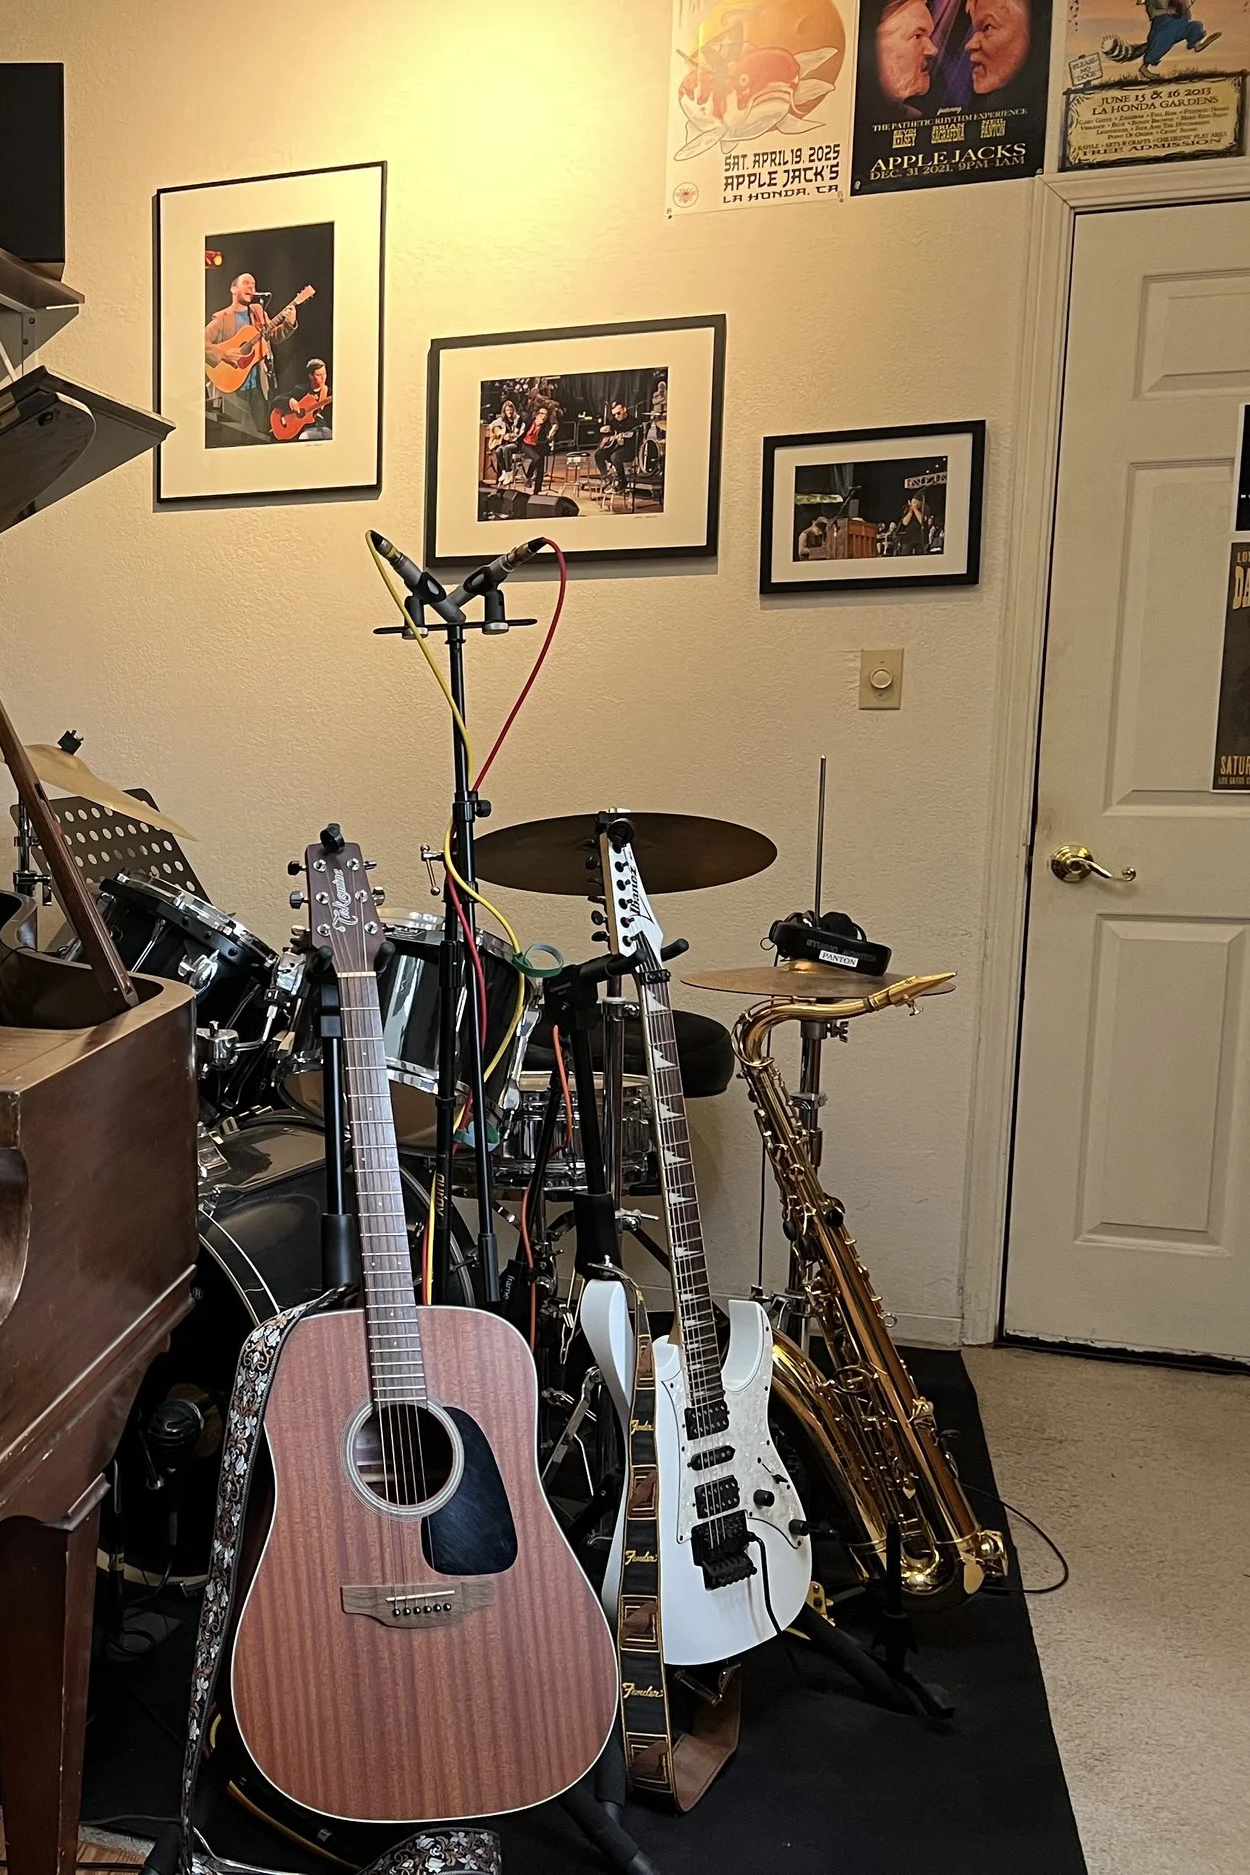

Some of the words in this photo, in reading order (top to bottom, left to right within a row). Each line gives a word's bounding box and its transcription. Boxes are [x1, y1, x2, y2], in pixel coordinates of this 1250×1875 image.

[1092, 108, 1108, 116] LA
[1111, 102, 1156, 113] HONDA
[1160, 96, 1219, 108] GARDENS
[1098, 95, 1130, 107] JUNE
[1135, 94, 1146, 102] 15
[1151, 90, 1163, 100] &
[1168, 88, 1180, 98] 16
[1184, 87, 1212, 96] 2013
[872, 124, 891, 132] THE
[892, 119, 934, 130] PATHETIC
[934, 114, 972, 126] RHYTHM
[973, 108, 1028, 121] EXPERIENCE
[1128, 138, 1222, 151] ADMISSION
[724, 153, 750, 172] SAT.
[752, 149, 788, 168] APRIL
[808, 144, 840, 162] 2025
[870, 152, 948, 172] APPLE
[952, 142, 1026, 162] JACKS
[724, 170, 778, 192] APPLE
[782, 162, 840, 188] JACK'S
[870, 170, 902, 180] DEC.
[906, 168, 918, 176] 31
[958, 156, 1025, 170] 9PM-1AM
[723, 194, 743, 204] LA
[816, 184, 838, 193] CA
[332, 868, 359, 933] Takamine
[630, 867, 640, 916] Ibanez
[806, 938, 838, 952] STUDIO
[822, 952, 856, 966] PANTON
[630, 1420, 654, 1434] Fender
[624, 1550, 658, 1566] Fender
[622, 1682, 664, 1698] Fender
